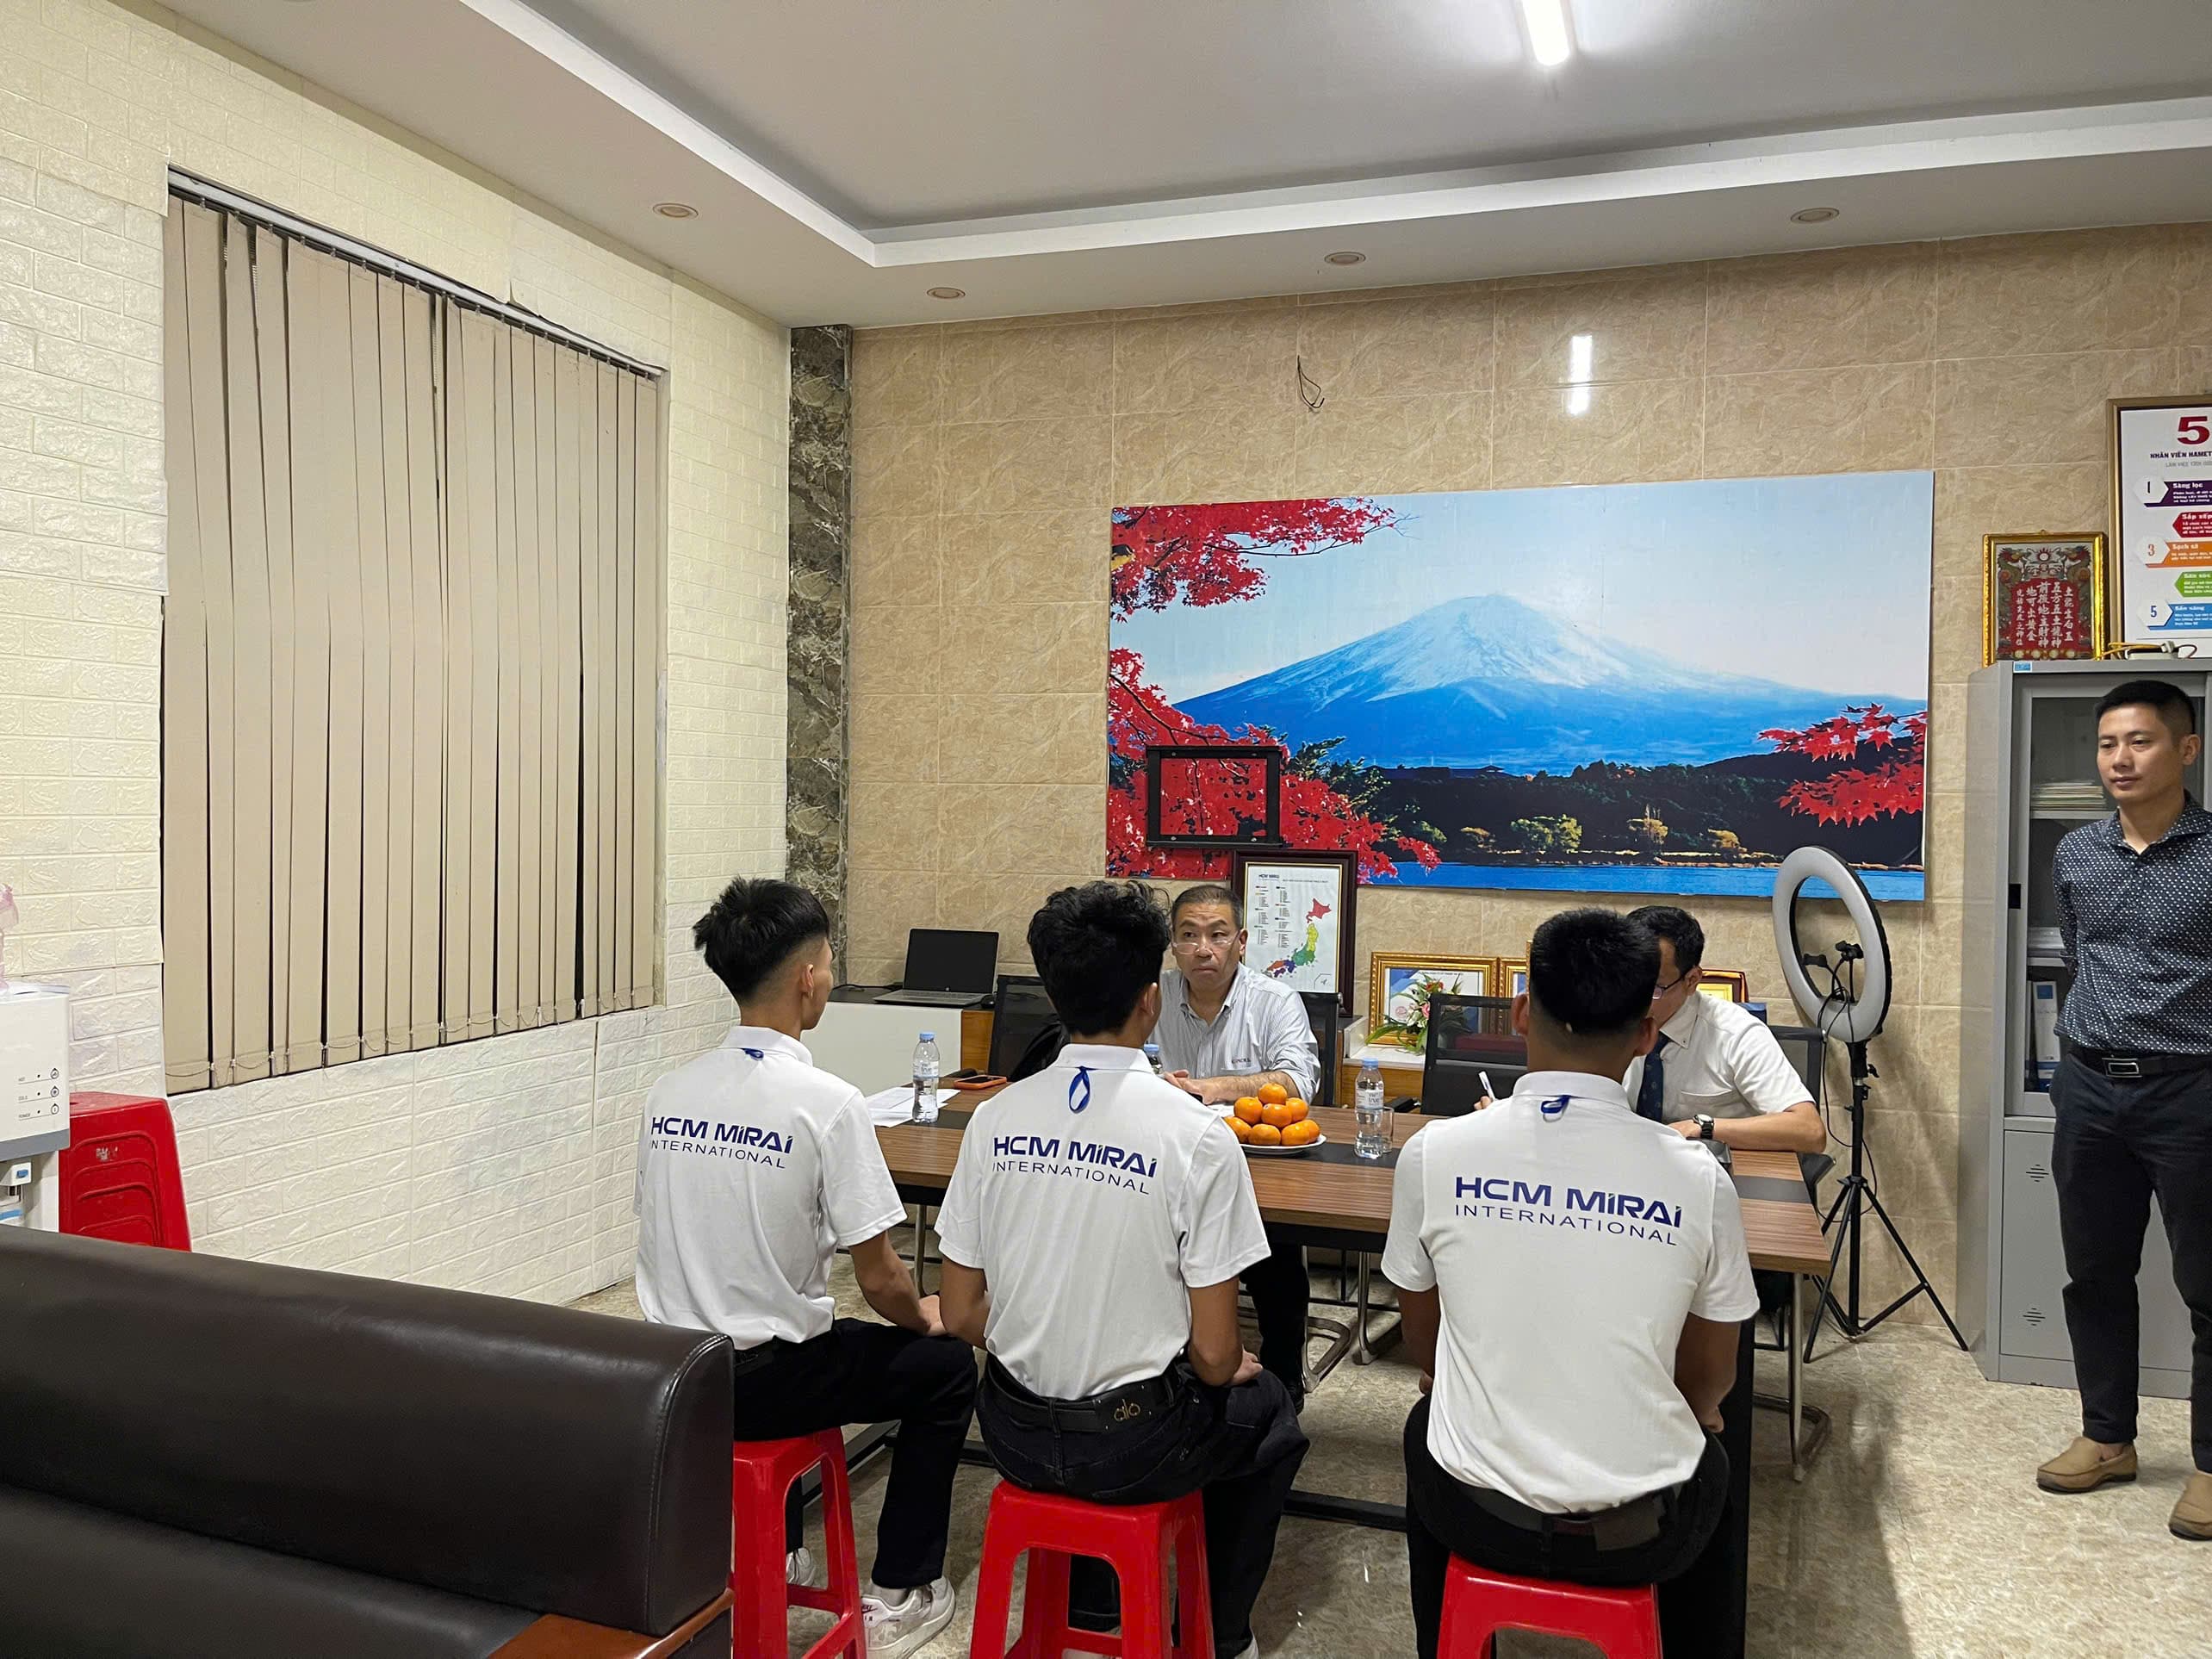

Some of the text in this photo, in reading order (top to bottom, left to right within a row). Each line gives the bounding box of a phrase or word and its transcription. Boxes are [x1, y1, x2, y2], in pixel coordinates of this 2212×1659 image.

[2147, 544, 2155, 556] 3
[2150, 605, 2158, 618] 5
[650, 1116, 709, 1140] HCM
[650, 1140, 786, 1170] NTERNATIONAL
[993, 1135, 1060, 1159] HCM
[992, 1160, 1150, 1196] INTERNATIONAL
[1455, 1176, 1552, 1207] HCM
[1455, 1204, 1678, 1246] INTERNATIONAL
